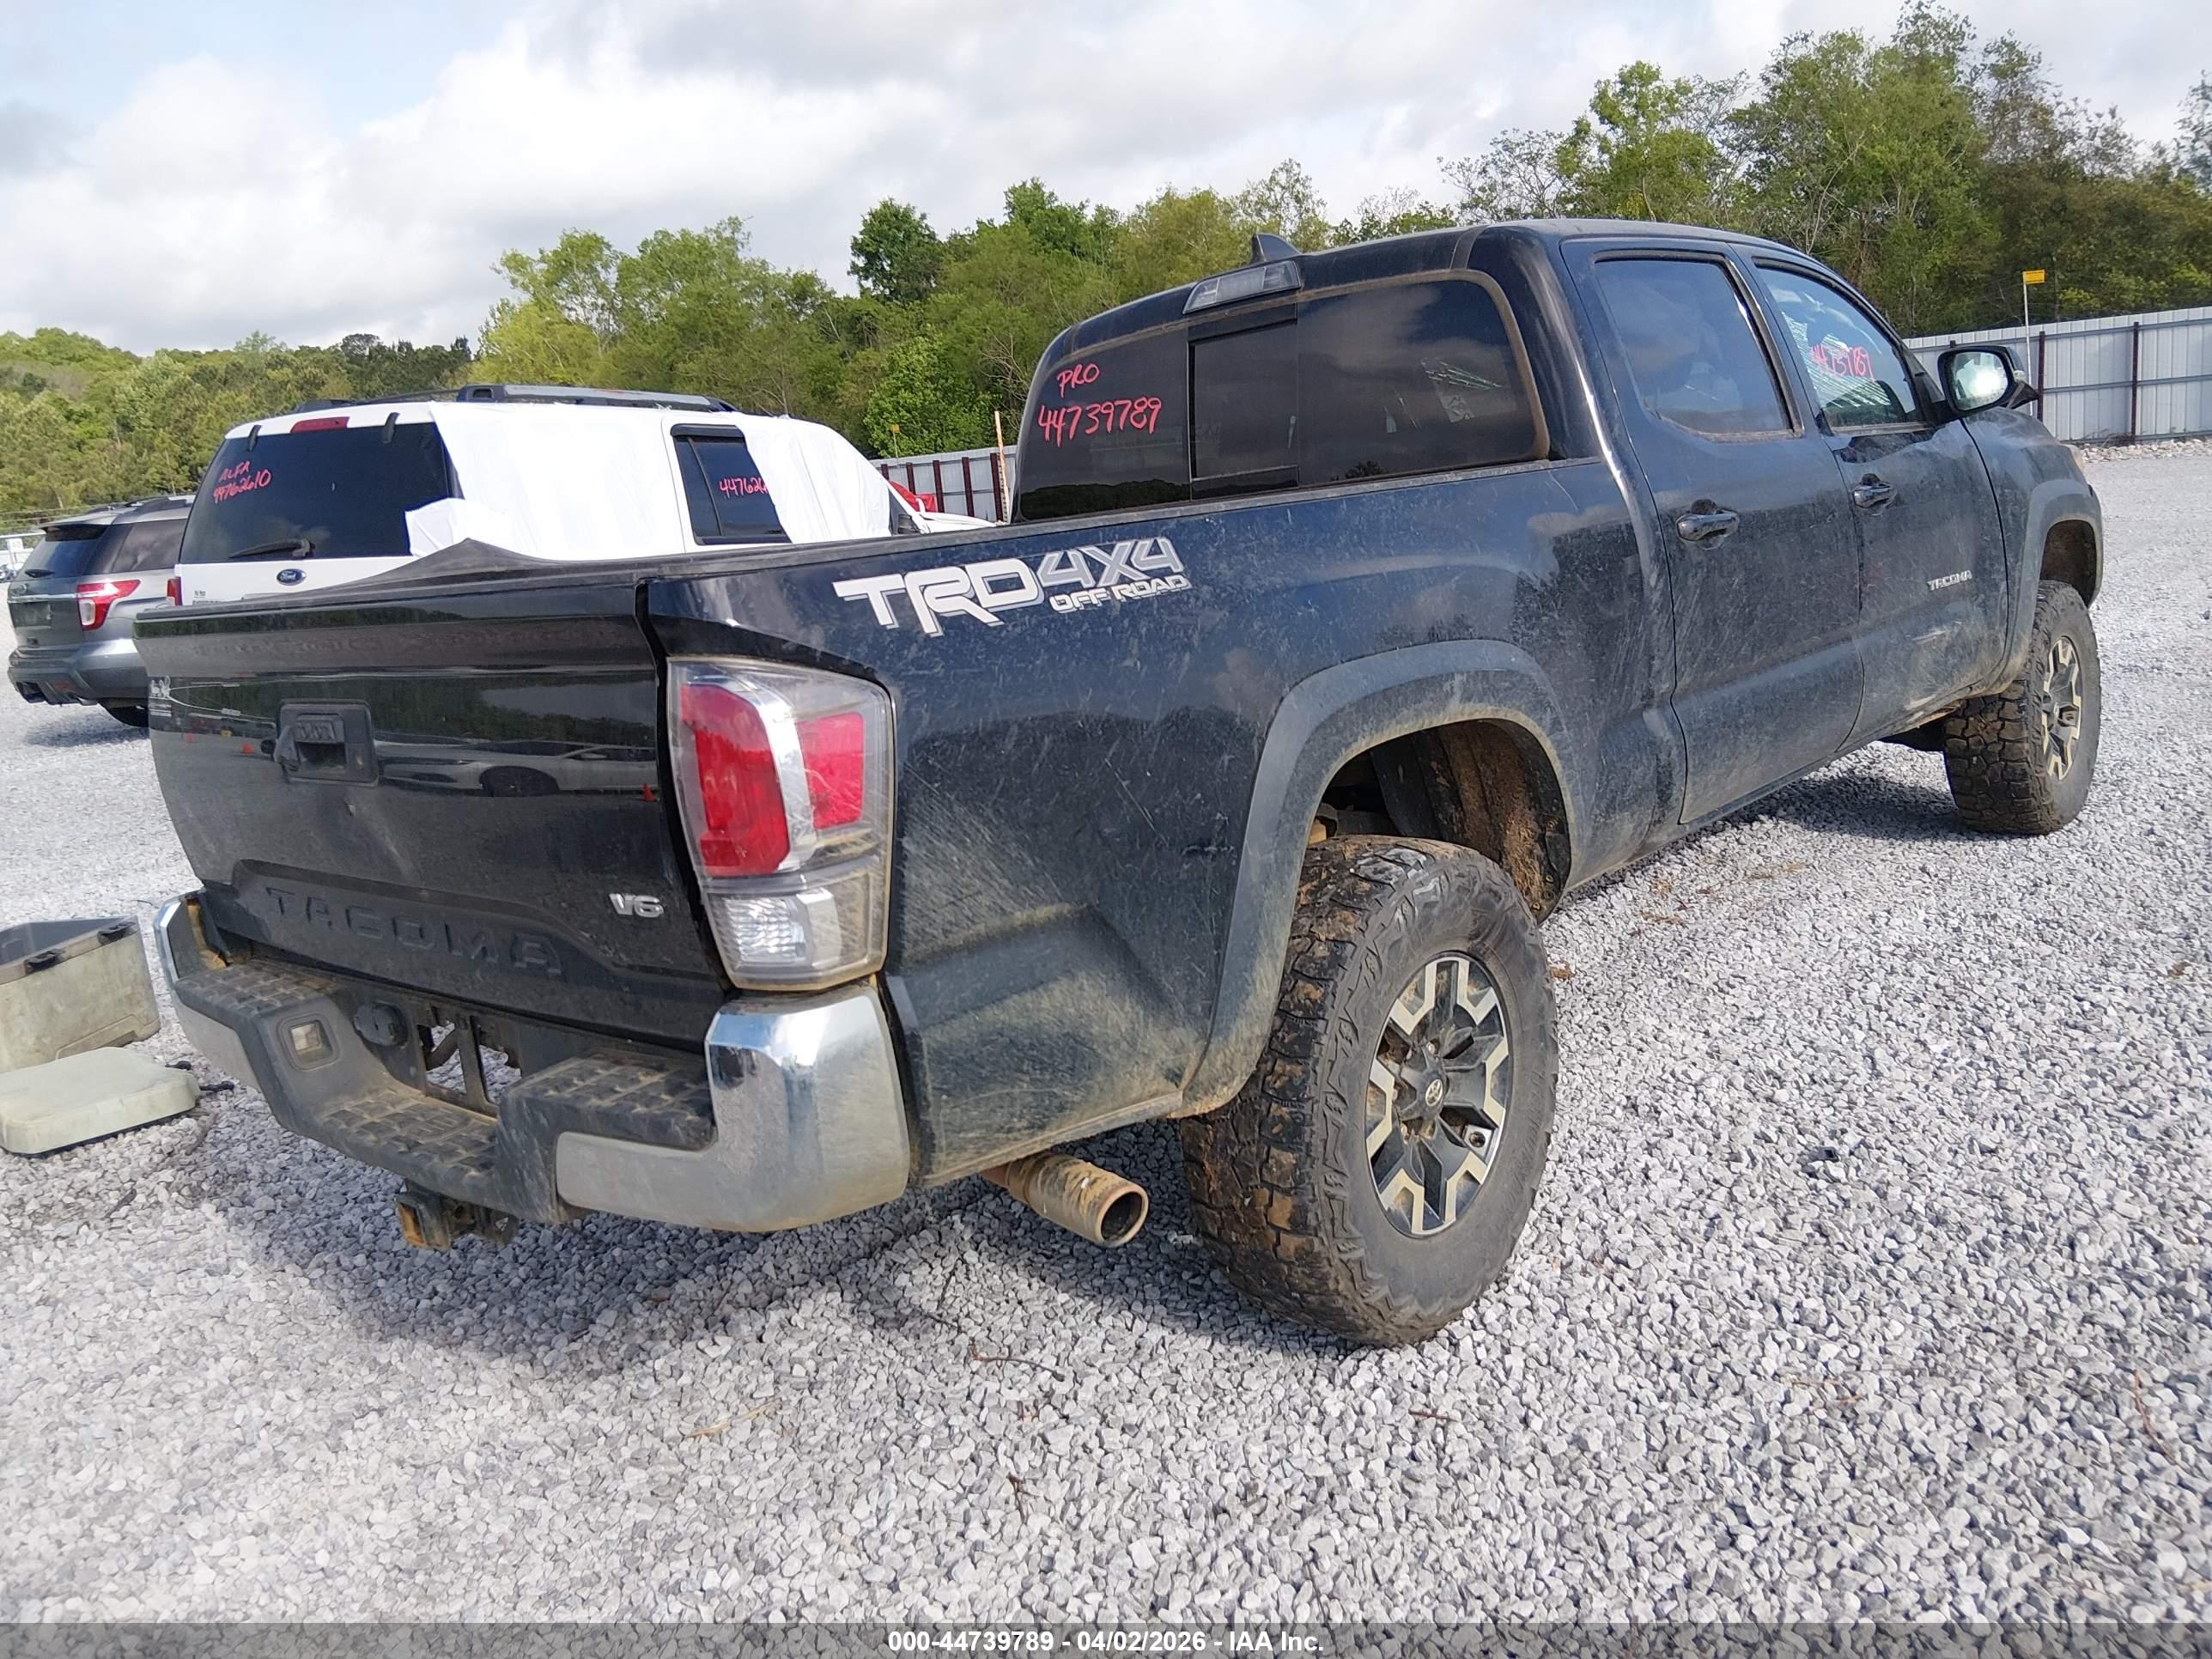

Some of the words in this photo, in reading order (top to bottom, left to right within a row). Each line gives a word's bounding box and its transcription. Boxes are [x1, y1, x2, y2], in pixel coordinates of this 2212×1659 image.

[1057, 363, 1100, 398] PRO
[1038, 397, 1162, 447] 44739789
[832, 558, 1046, 639] TRD
[1036, 536, 1185, 588] 4X4
[1049, 588, 1115, 615] OFF
[1116, 574, 1193, 602] ROAD
[1926, 569, 1972, 592] TACOMA
[609, 892, 664, 919] V6
[265, 887, 562, 976] TACOMA
